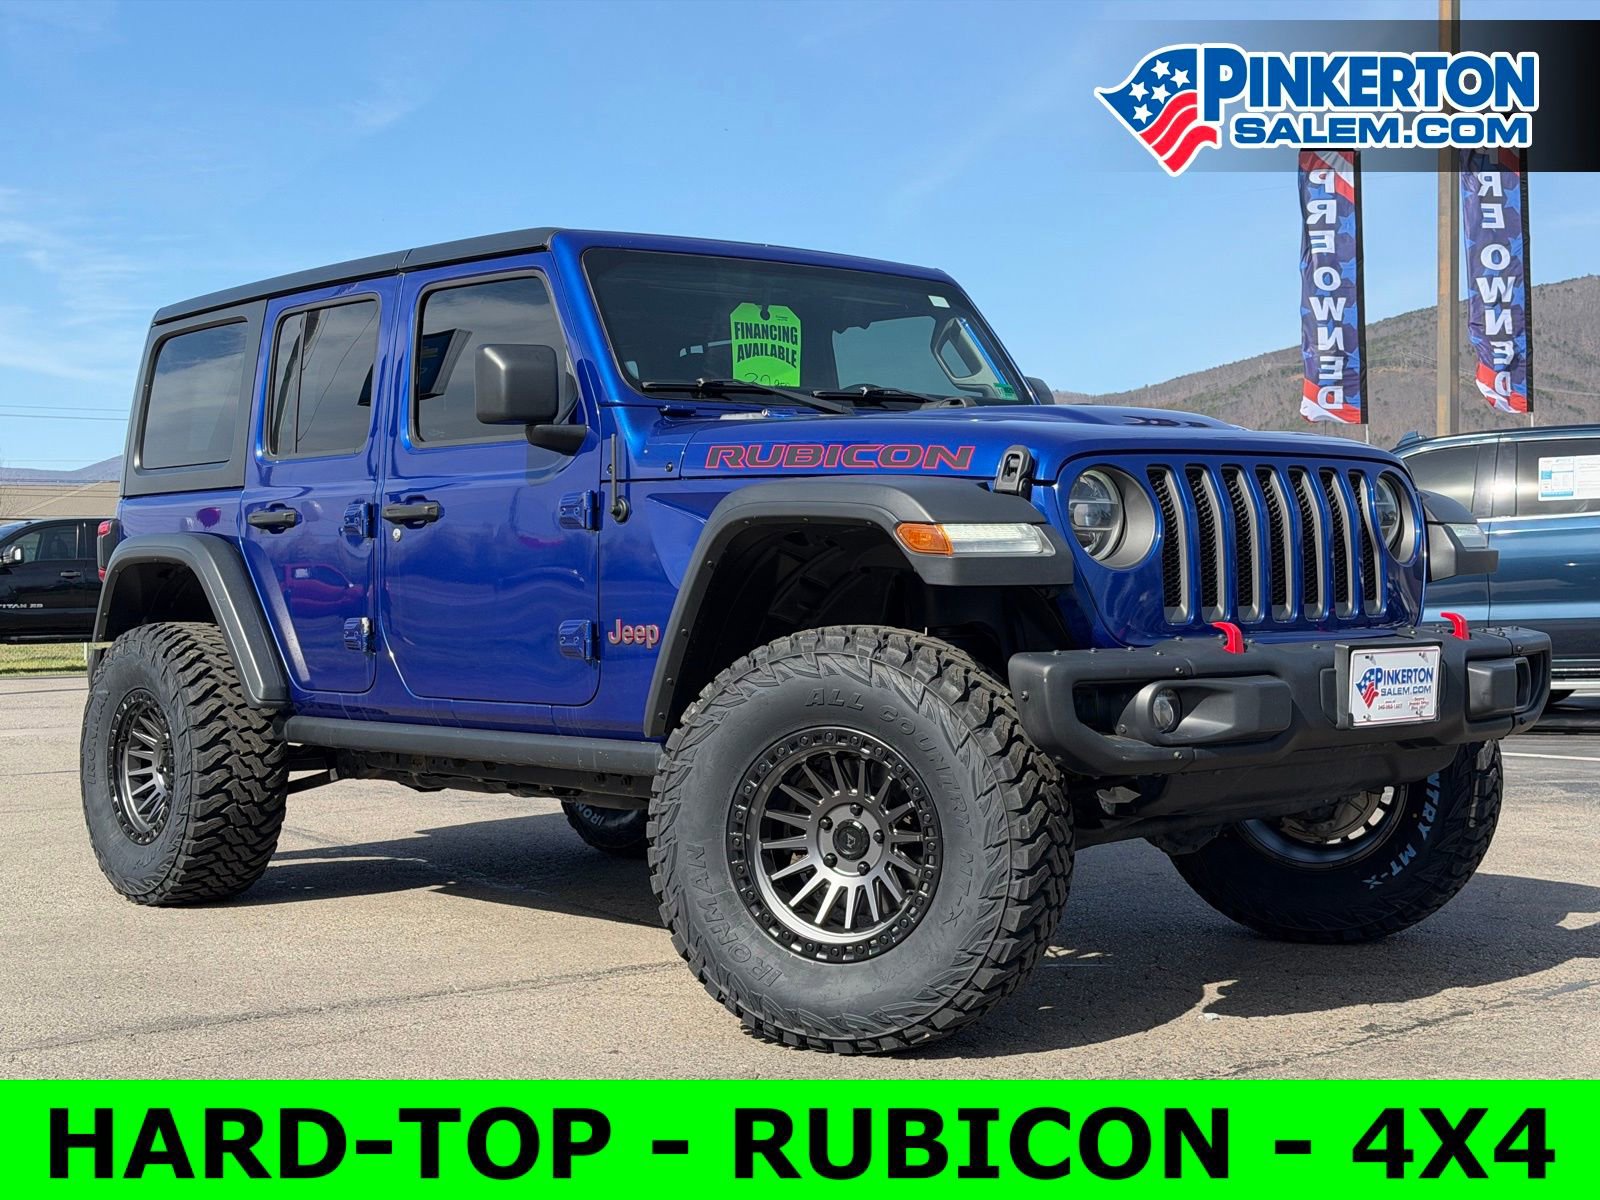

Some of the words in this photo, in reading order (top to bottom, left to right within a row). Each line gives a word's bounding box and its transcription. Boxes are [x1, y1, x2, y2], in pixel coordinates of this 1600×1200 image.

[733, 321, 798, 345] FINANCING
[736, 343, 798, 369] AVAILABLE
[704, 444, 976, 470] RUBICON
[607, 618, 660, 650] Jeep
[1375, 667, 1434, 690] PINKERTON
[1380, 685, 1432, 697] SALEM.COM
[1417, 771, 1442, 841] NTRY
[685, 844, 783, 987] IRONMAN
[804, 687, 865, 712] ALL
[1361, 842, 1418, 890] MT-X
